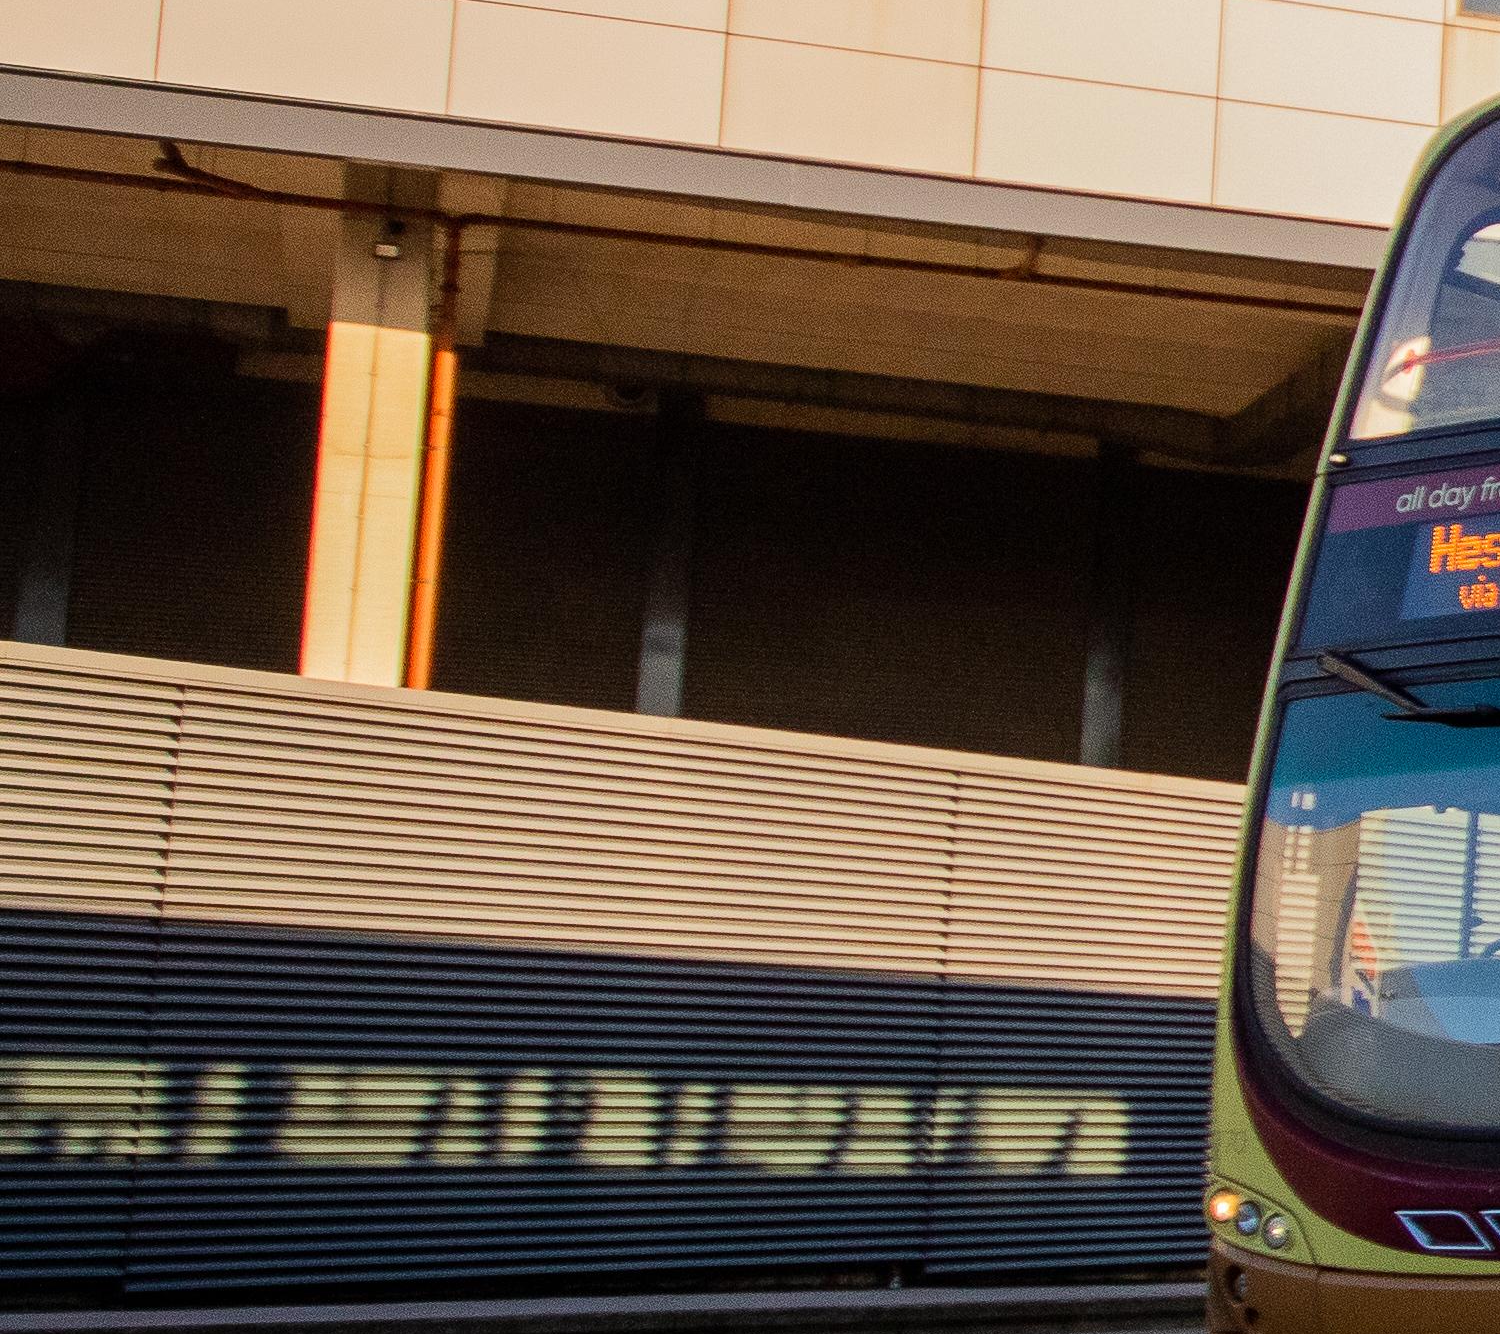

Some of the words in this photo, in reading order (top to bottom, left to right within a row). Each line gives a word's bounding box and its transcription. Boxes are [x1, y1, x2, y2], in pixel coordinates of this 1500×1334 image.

[1396, 485, 1425, 512] all
[1428, 483, 1475, 510] day
[1458, 575, 1500, 610] via
